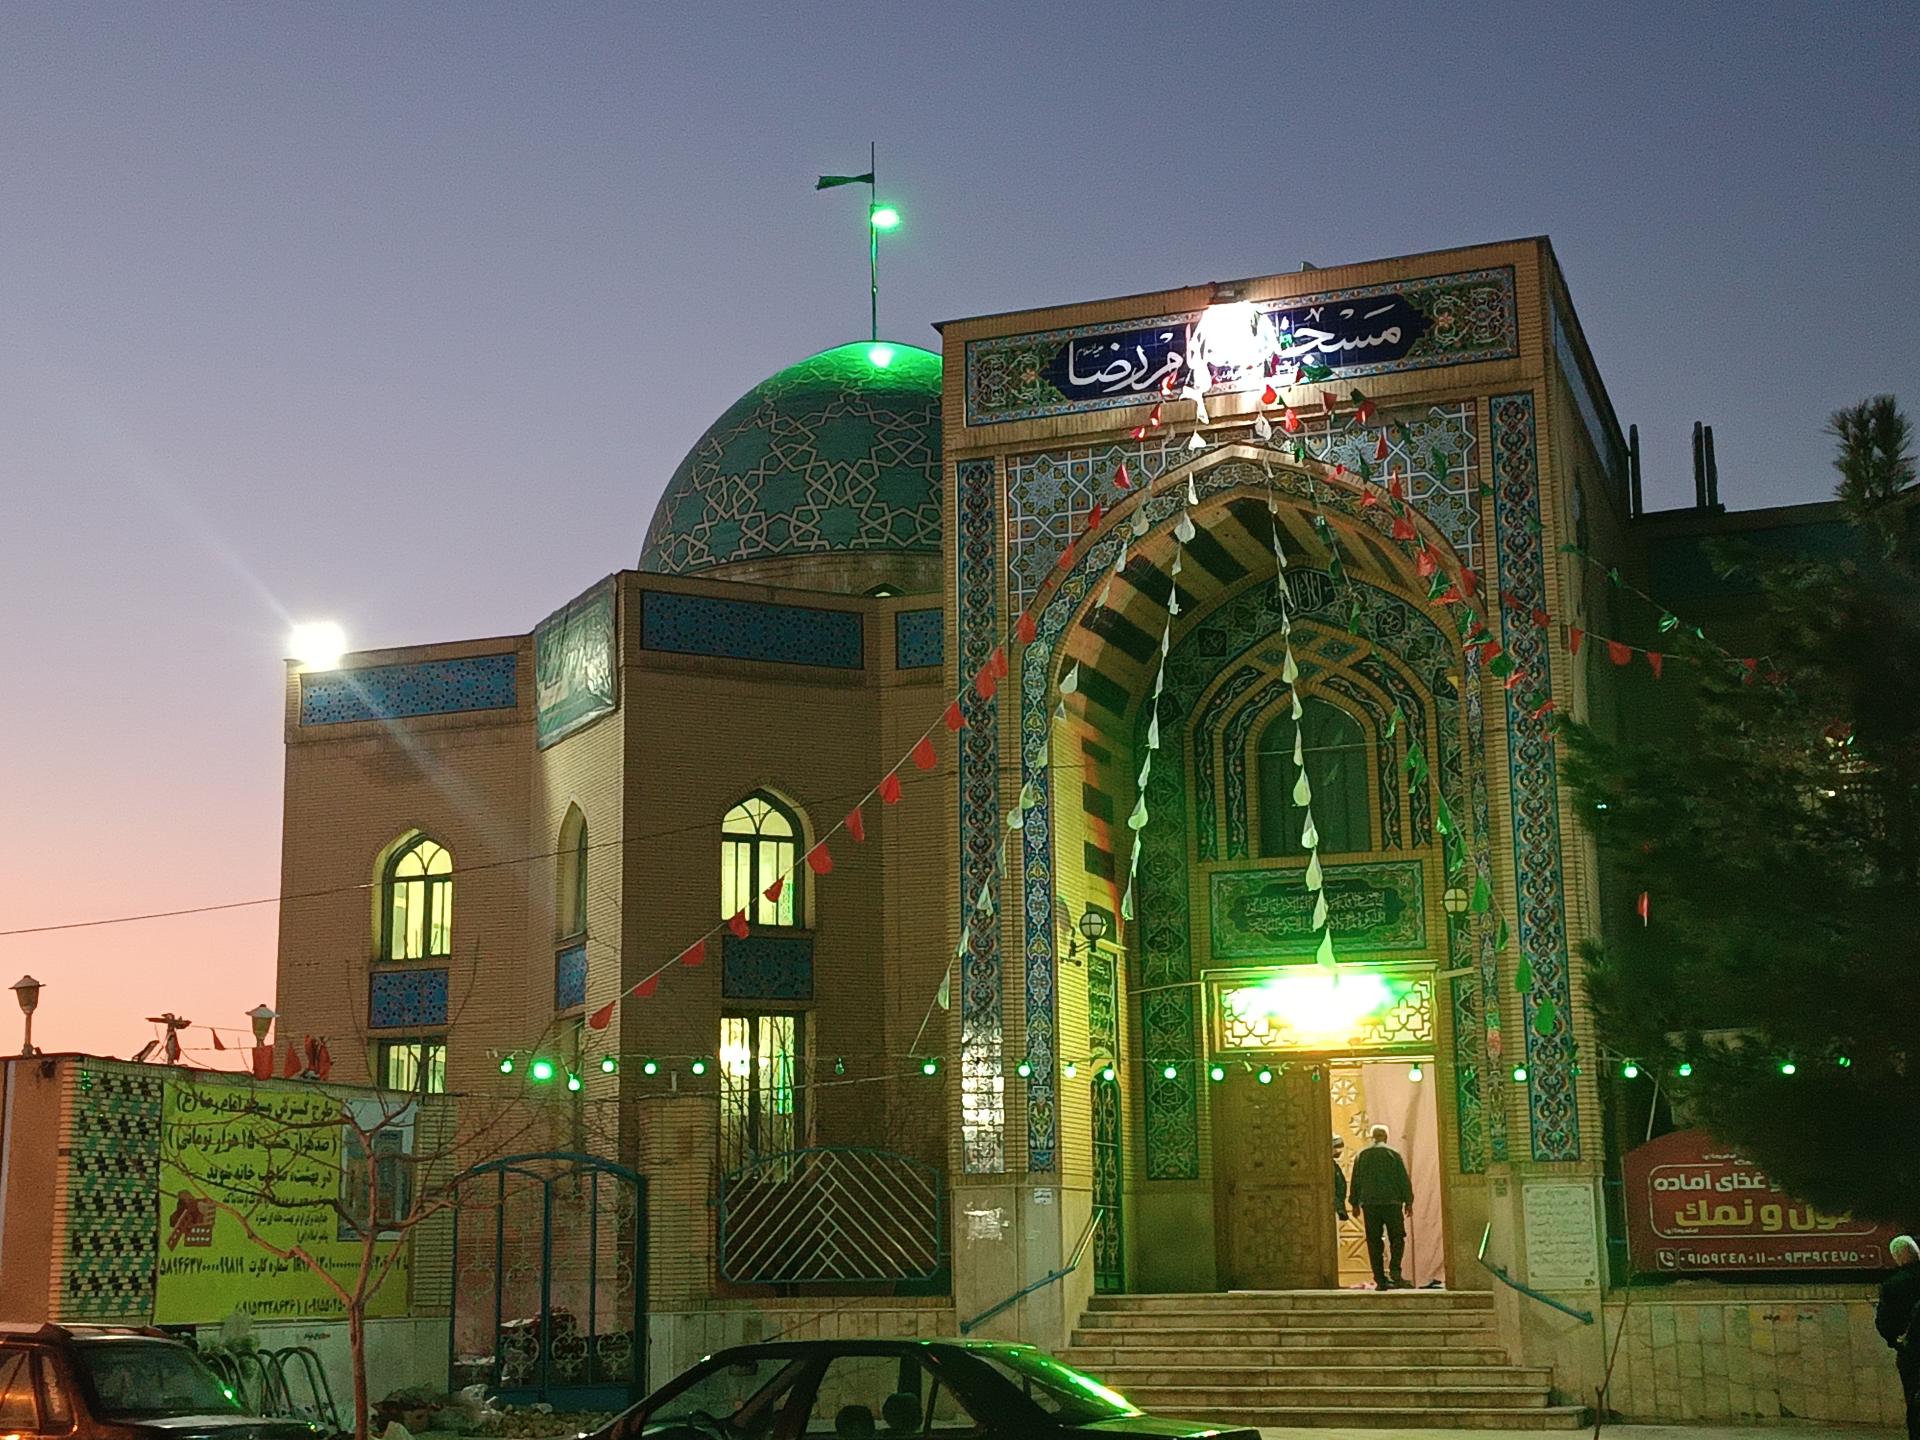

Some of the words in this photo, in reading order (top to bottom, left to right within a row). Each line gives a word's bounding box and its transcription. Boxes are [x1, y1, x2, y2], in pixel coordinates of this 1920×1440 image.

[1272, 303, 1402, 366] مسج
[1068, 340, 1148, 393] رضا
[312, 1100, 333, 1120] طرح
[235, 1164, 255, 1181] خانه
[320, 1170, 333, 1188] در
[1653, 1170, 1712, 1192] آماده
[1715, 1171, 1767, 1193] غذای
[1759, 1203, 1783, 1232] و
[249, 1257, 269, 1278] کارت
[269, 1257, 288, 1278] شماره
